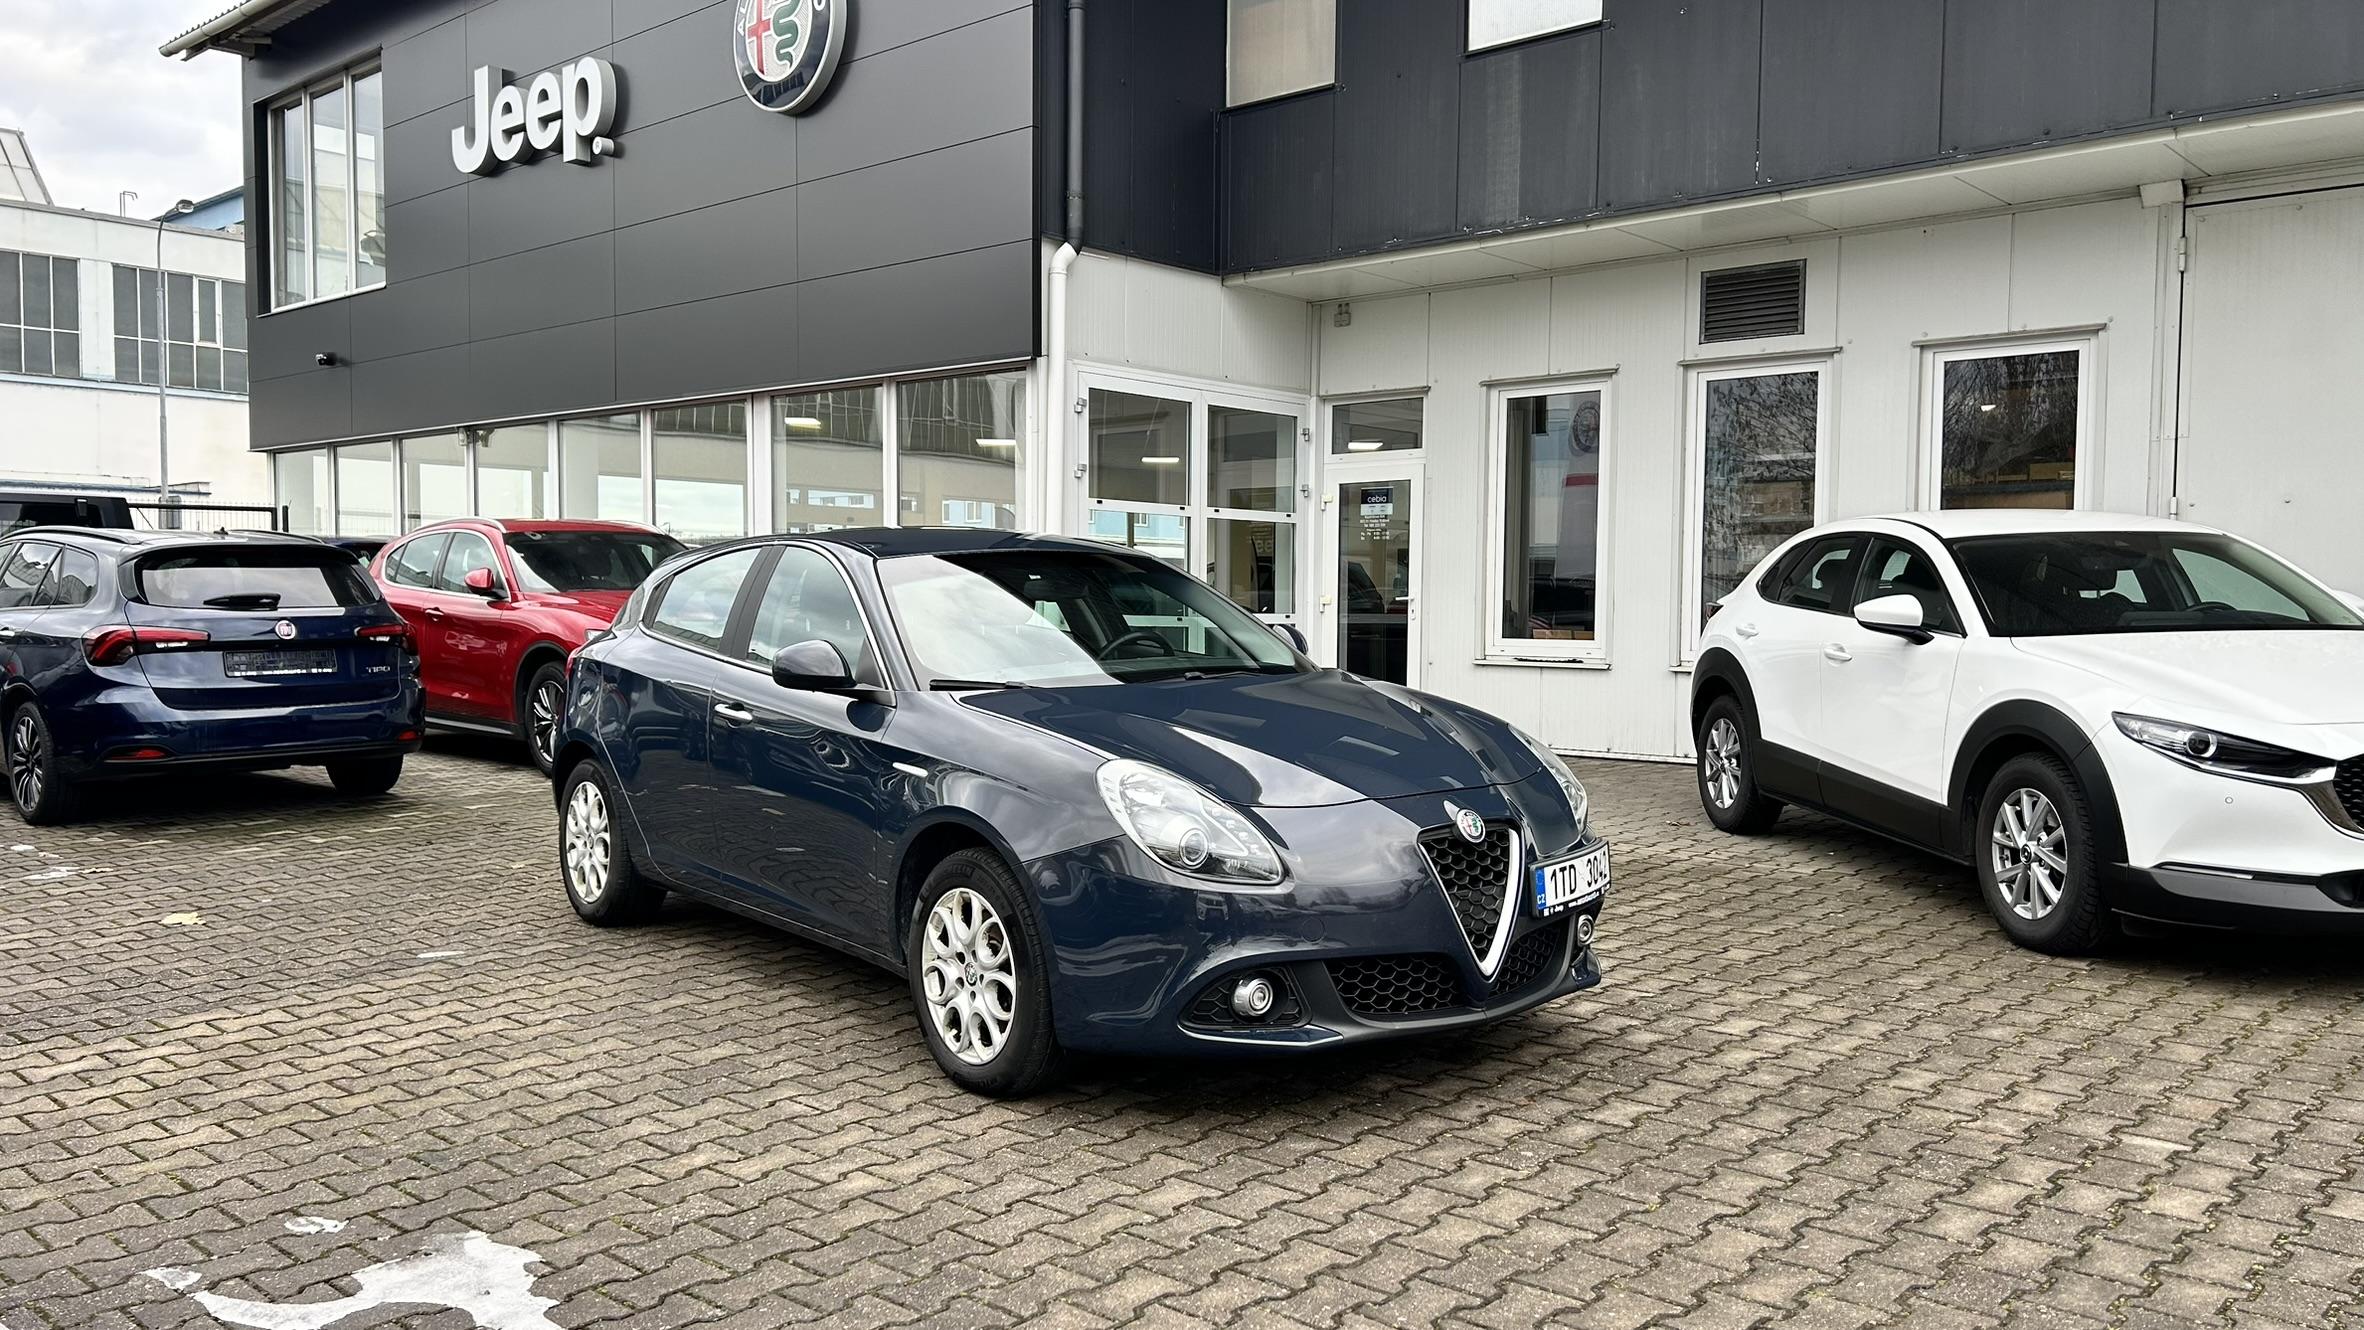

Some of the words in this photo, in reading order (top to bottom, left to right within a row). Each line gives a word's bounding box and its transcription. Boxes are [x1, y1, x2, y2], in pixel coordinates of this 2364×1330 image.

[452, 56, 616, 175] Jeep
[1536, 893, 1546, 904] CZ
[1550, 864, 1577, 900] 1TD
